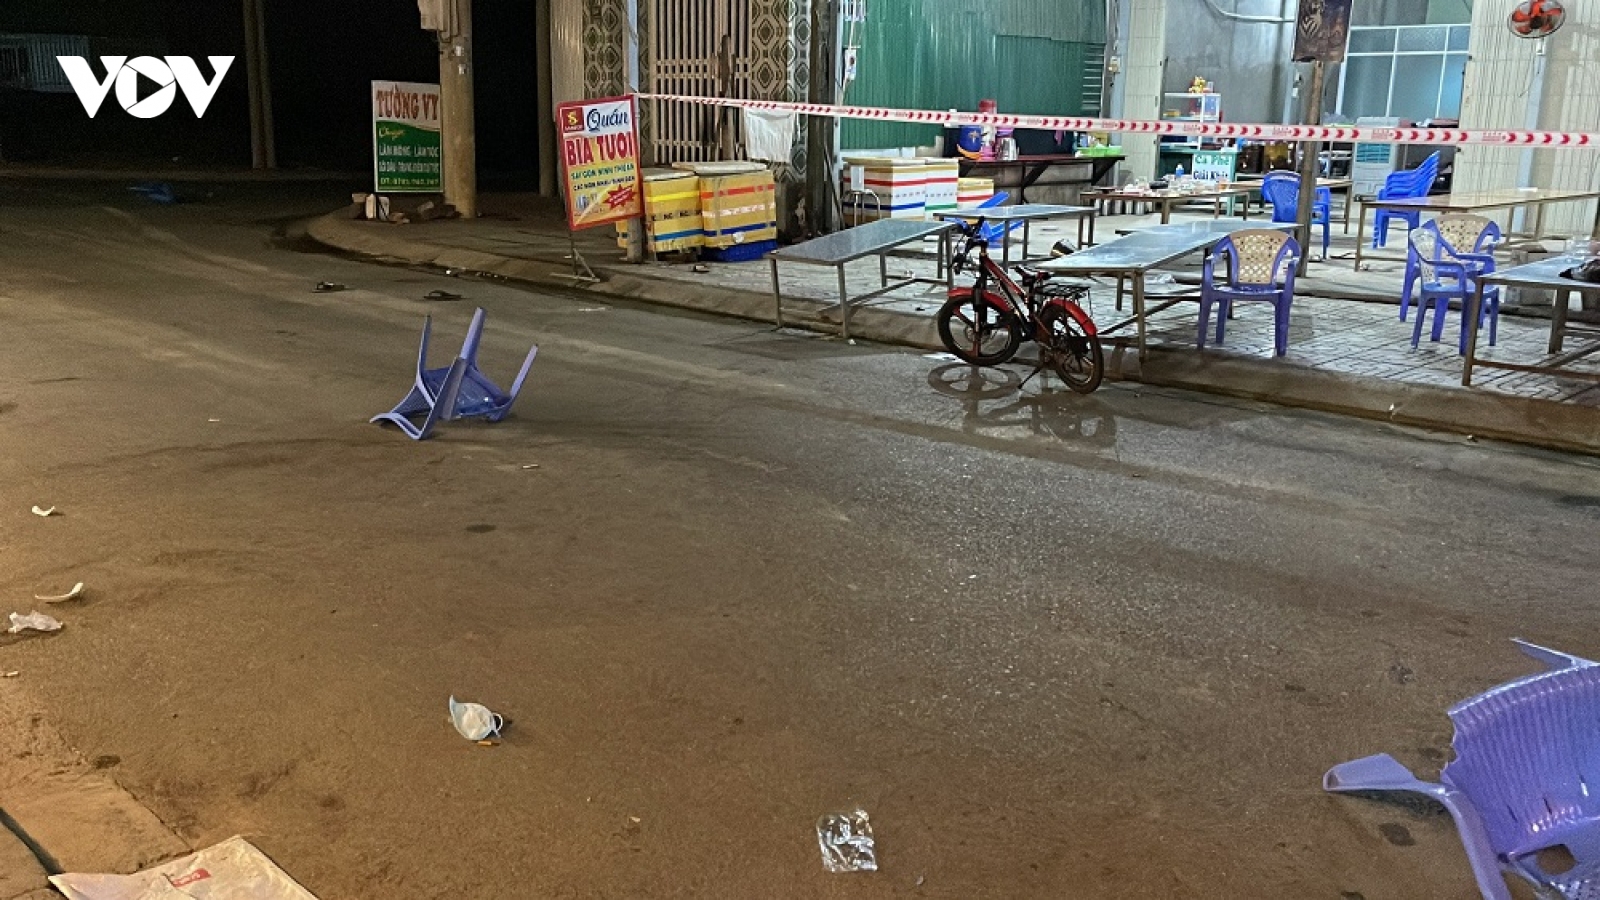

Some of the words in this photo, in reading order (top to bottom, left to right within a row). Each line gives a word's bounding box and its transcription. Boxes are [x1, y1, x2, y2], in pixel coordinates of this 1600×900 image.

[422, 93, 438, 120] VY
[587, 108, 628, 131] Quán
[566, 138, 594, 167] BIA
